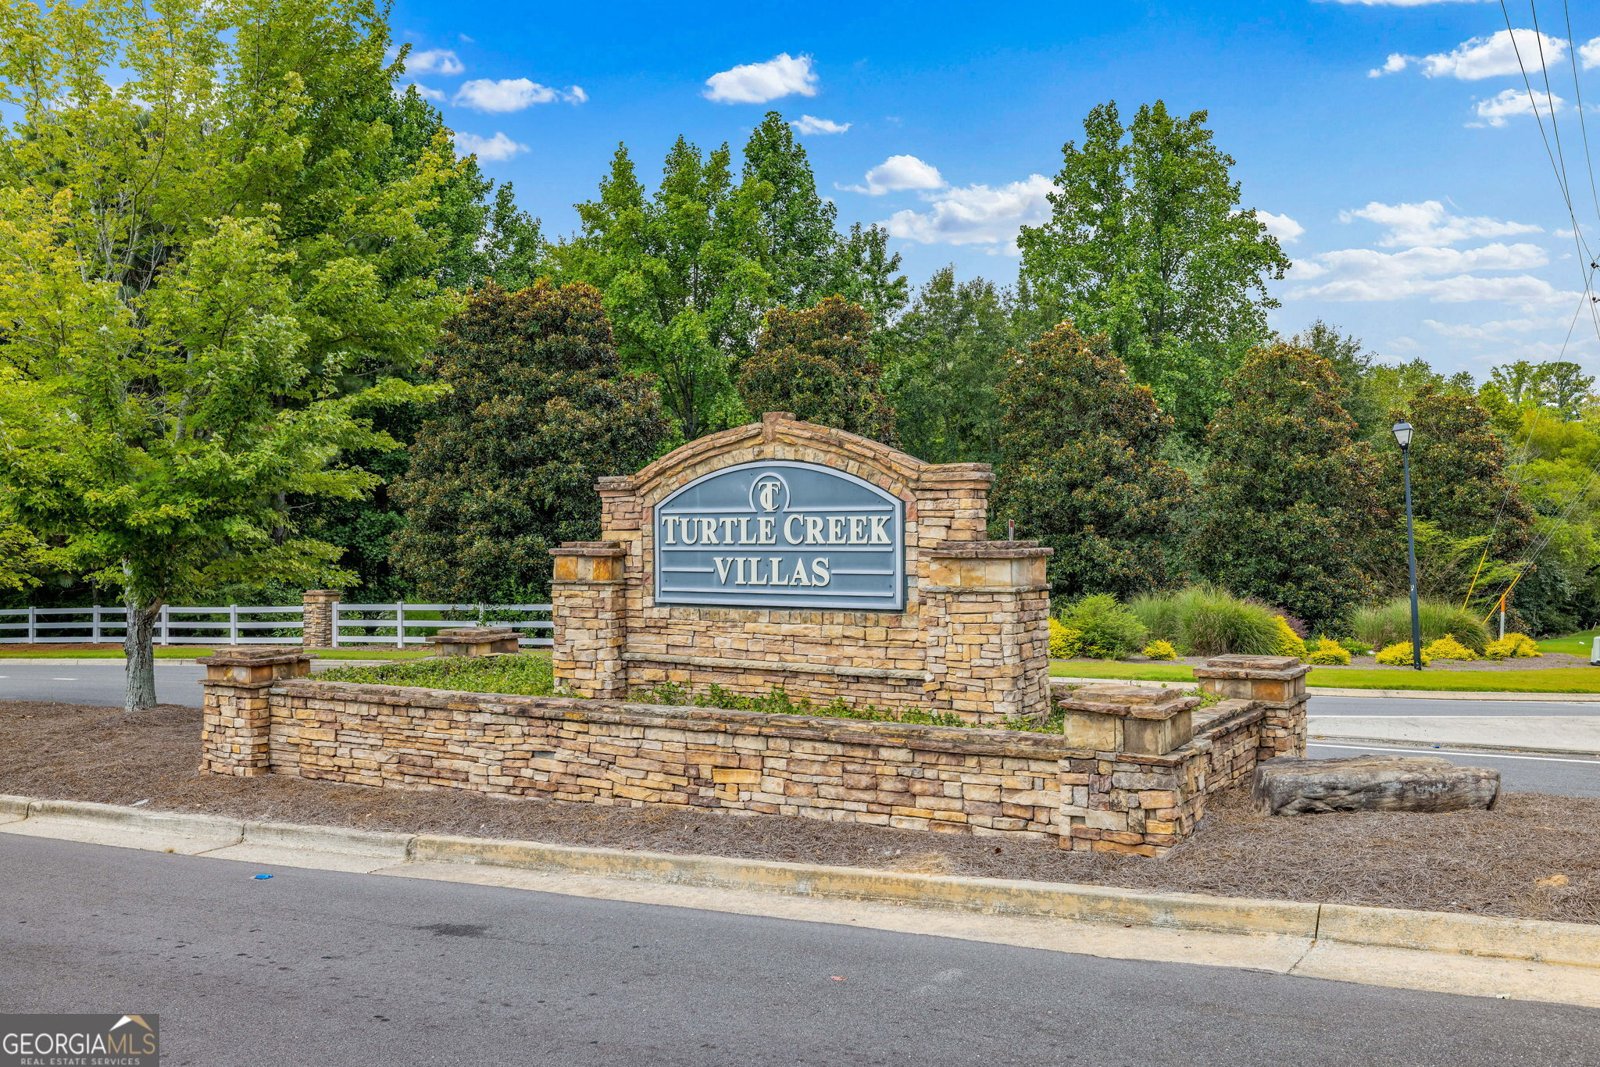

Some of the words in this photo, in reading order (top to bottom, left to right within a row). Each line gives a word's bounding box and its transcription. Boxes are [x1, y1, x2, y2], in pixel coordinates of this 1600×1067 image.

[662, 514, 777, 545] TURTLE
[783, 513, 892, 545] CREEK
[713, 556, 831, 587] VILLAS
